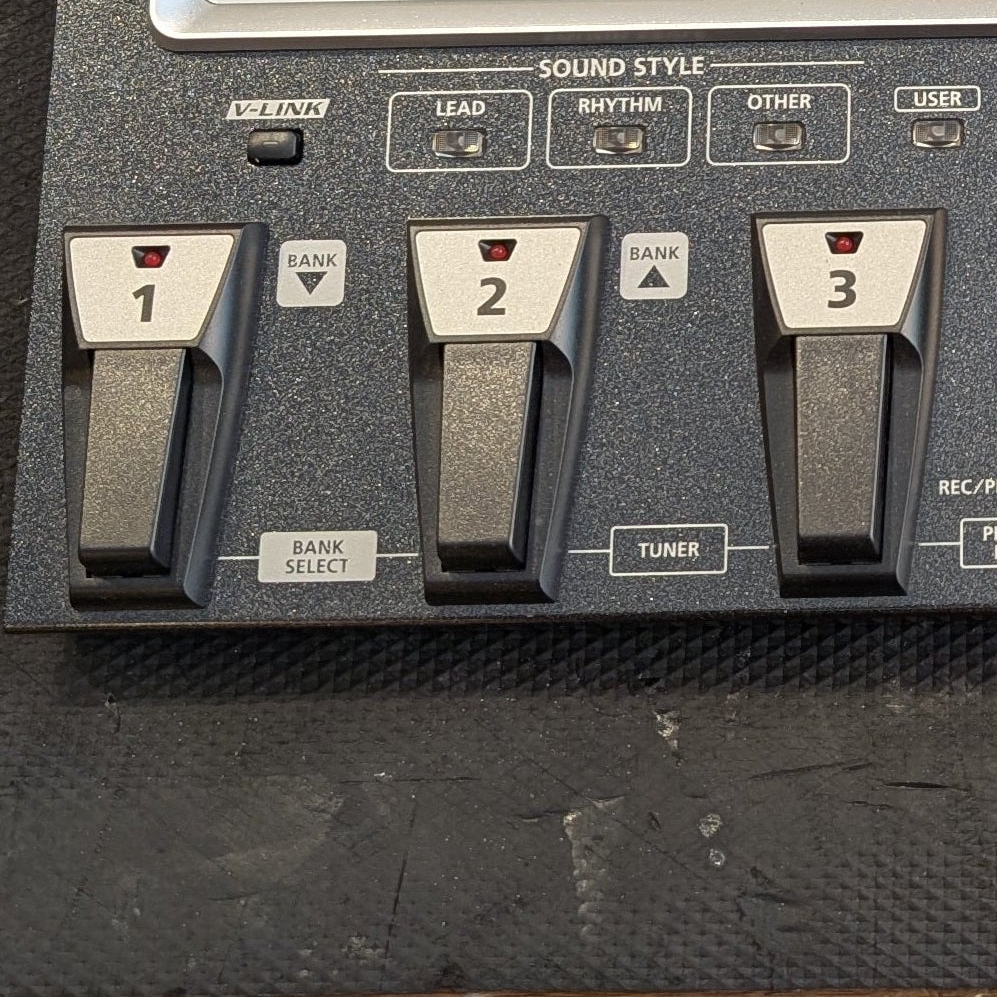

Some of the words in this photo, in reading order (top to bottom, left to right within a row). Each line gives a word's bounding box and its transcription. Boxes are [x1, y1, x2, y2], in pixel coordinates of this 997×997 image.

[538, 57, 626, 79] SOUND
[633, 55, 704, 77] STYLE
[578, 96, 662, 113] RHYTHM
[747, 93, 812, 110] OTHER
[913, 90, 962, 108] USER
[234, 102, 323, 117] V-LINK
[436, 100, 486, 117] LEAD
[287, 253, 337, 268] BANK
[629, 245, 680, 261] BANK
[476, 277, 508, 316] 2
[827, 269, 857, 308] 3
[132, 284, 155, 323] 1
[292, 539, 345, 555] BANK
[638, 541, 700, 559] TUNER
[285, 558, 350, 574] SELECT
